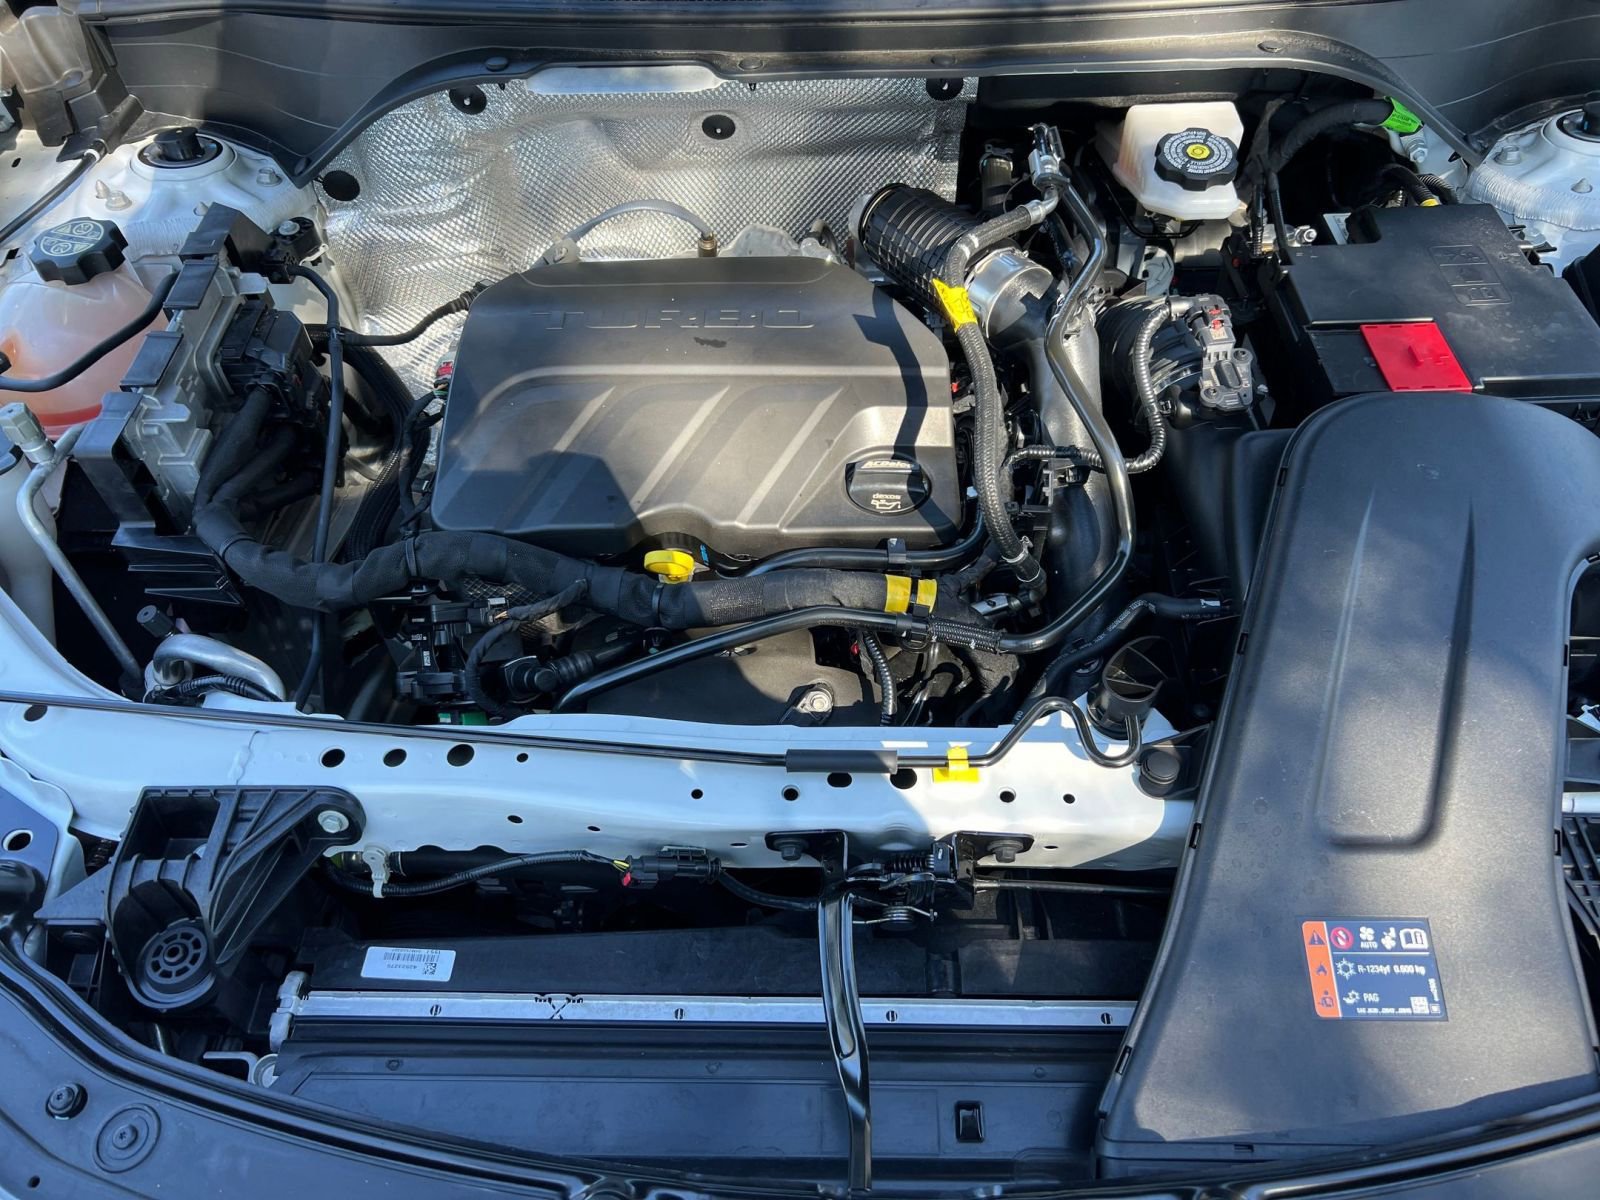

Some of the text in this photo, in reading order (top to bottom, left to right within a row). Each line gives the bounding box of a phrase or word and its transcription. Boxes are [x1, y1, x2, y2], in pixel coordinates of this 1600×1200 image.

[531, 310, 815, 330] TURBO
[1415, 964, 1426, 976] kg
[1362, 992, 1379, 1002] PAG
